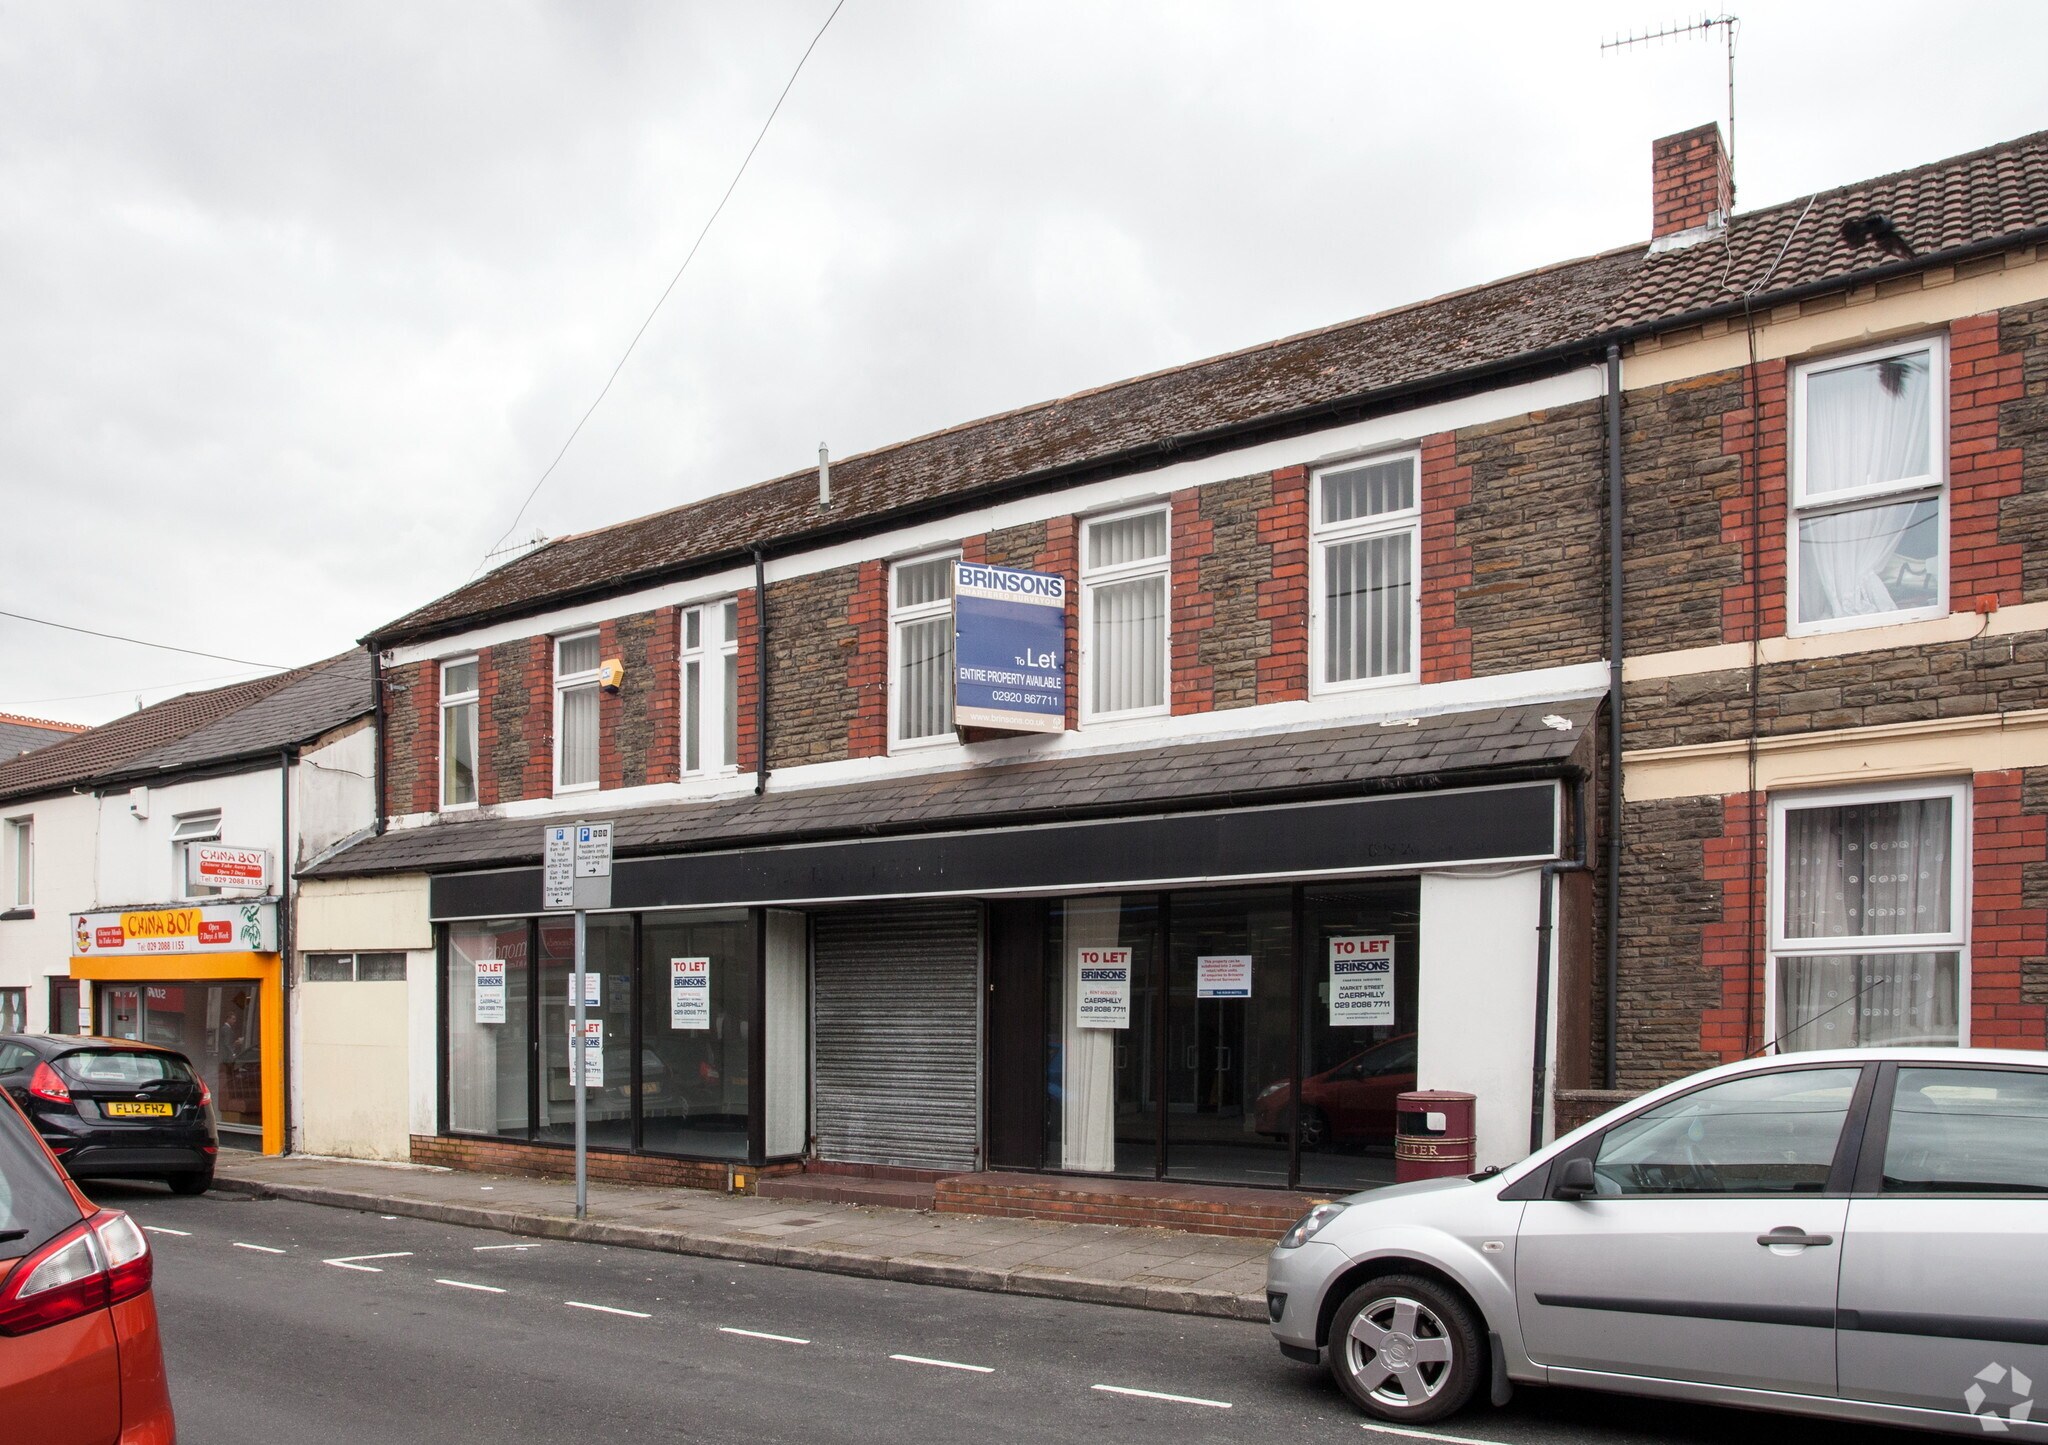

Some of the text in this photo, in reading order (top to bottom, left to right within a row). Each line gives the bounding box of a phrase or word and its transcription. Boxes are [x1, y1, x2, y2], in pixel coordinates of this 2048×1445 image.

[960, 568, 1062, 598] BRINSONS
[960, 588, 1062, 605] CHARTERED SURVEYORS
[1015, 648, 1057, 669] To Let
[960, 668, 1062, 689] ENTIRE PROPERTY AVAILABLE
[992, 690, 1058, 706] 02920 867711
[970, 712, 1045, 726] www.brinsons.co.uk
[200, 849, 262, 863] CHINA BOY
[128, 912, 194, 936] CHINA BOY
[208, 923, 219, 932] Open
[112, 937, 122, 945] Away
[204, 932, 213, 942] Days
[147, 942, 156, 951] 029
[158, 942, 170, 951] 2088
[172, 941, 184, 950] 1155
[1334, 940, 1390, 954] TO LET
[1082, 952, 1127, 963] TO LET
[478, 964, 487, 972] TO
[490, 964, 503, 972] LET
[674, 962, 706, 972] TO LET
[1334, 962, 1390, 972] BRINSONS
[1082, 970, 1126, 979] BRINSONS
[116, 1103, 166, 1113] FL12 FHZ
[1398, 1144, 1439, 1155] ITTER
